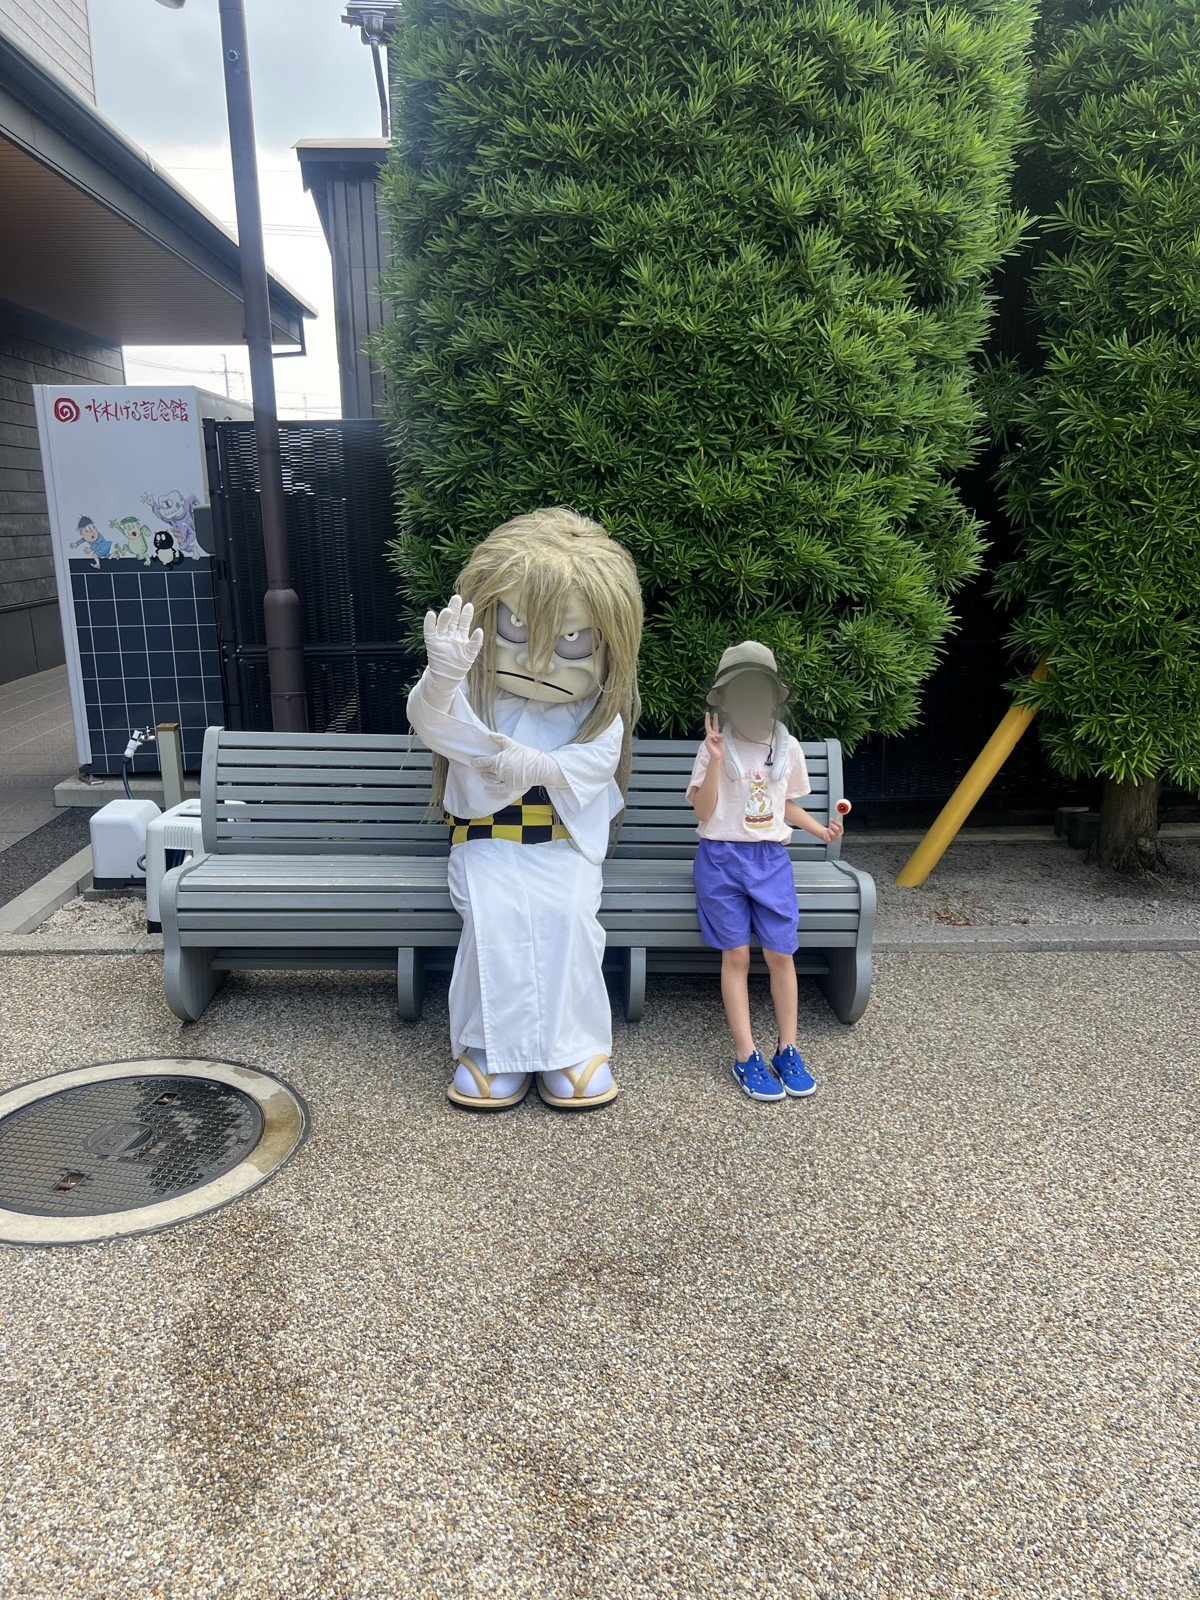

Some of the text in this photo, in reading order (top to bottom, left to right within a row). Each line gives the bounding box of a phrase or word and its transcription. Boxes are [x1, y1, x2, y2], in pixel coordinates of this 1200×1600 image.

[85, 398, 189, 422] 水木しげる記念館
